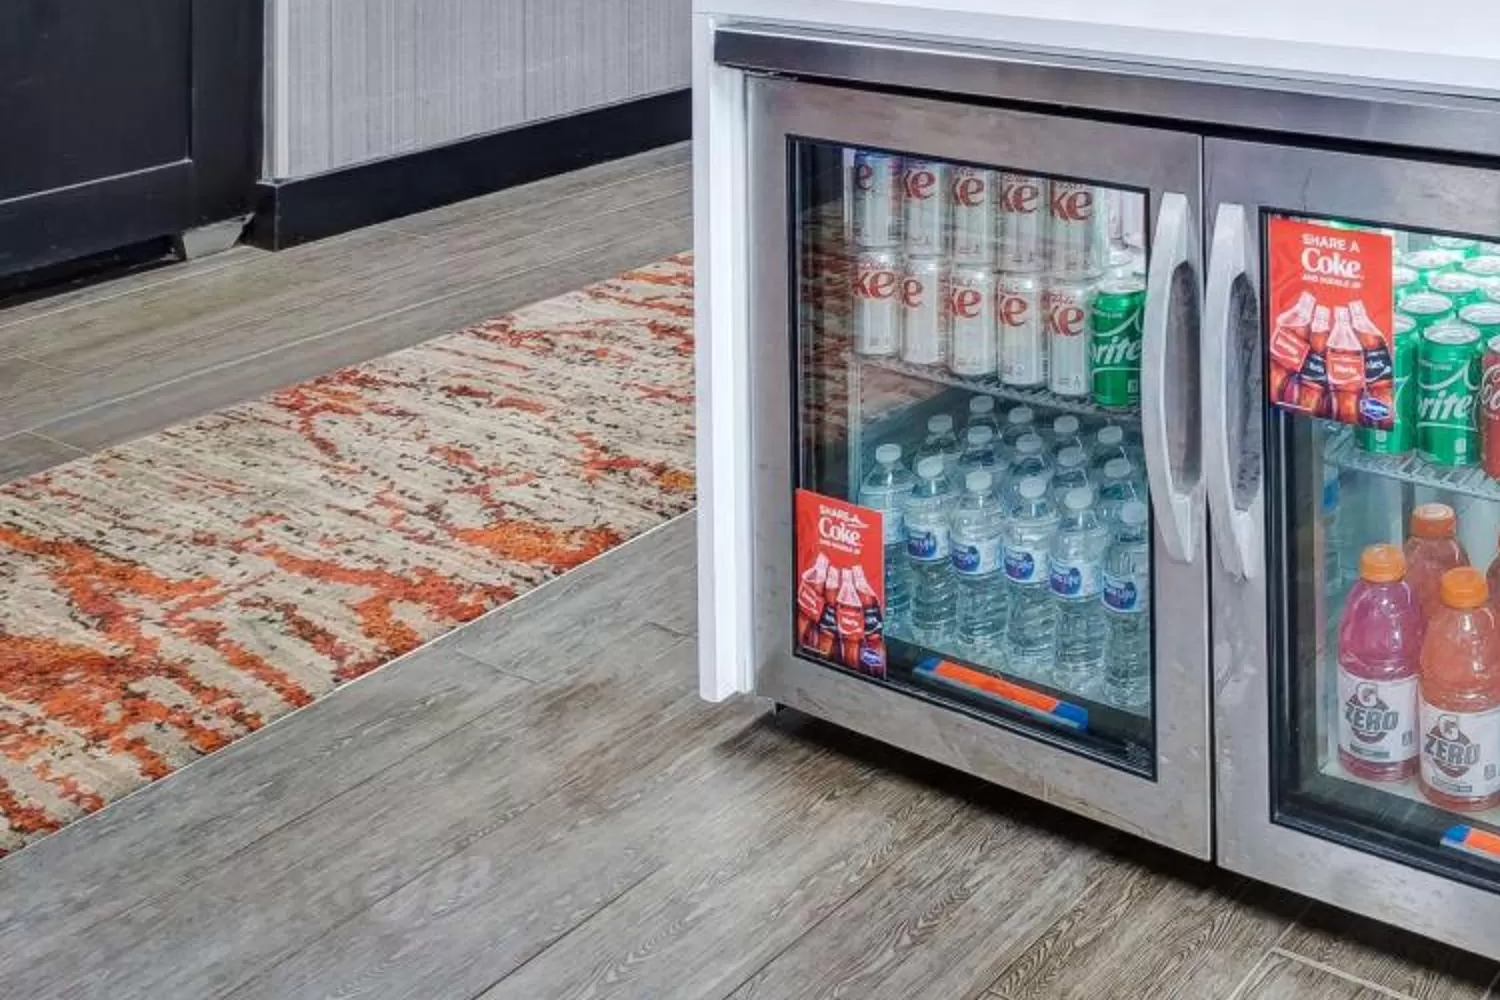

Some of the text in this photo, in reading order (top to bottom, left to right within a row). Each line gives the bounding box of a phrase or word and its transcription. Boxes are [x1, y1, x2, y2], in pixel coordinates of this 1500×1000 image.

[1302, 233, 1361, 253] SHARE A
[1301, 248, 1361, 278] Coke
[1091, 335, 1141, 364] rite
[1417, 391, 1473, 421] rite
[819, 517, 862, 547] Coke
[1345, 704, 1399, 731] ZERO
[1424, 734, 1480, 765] ZERO
